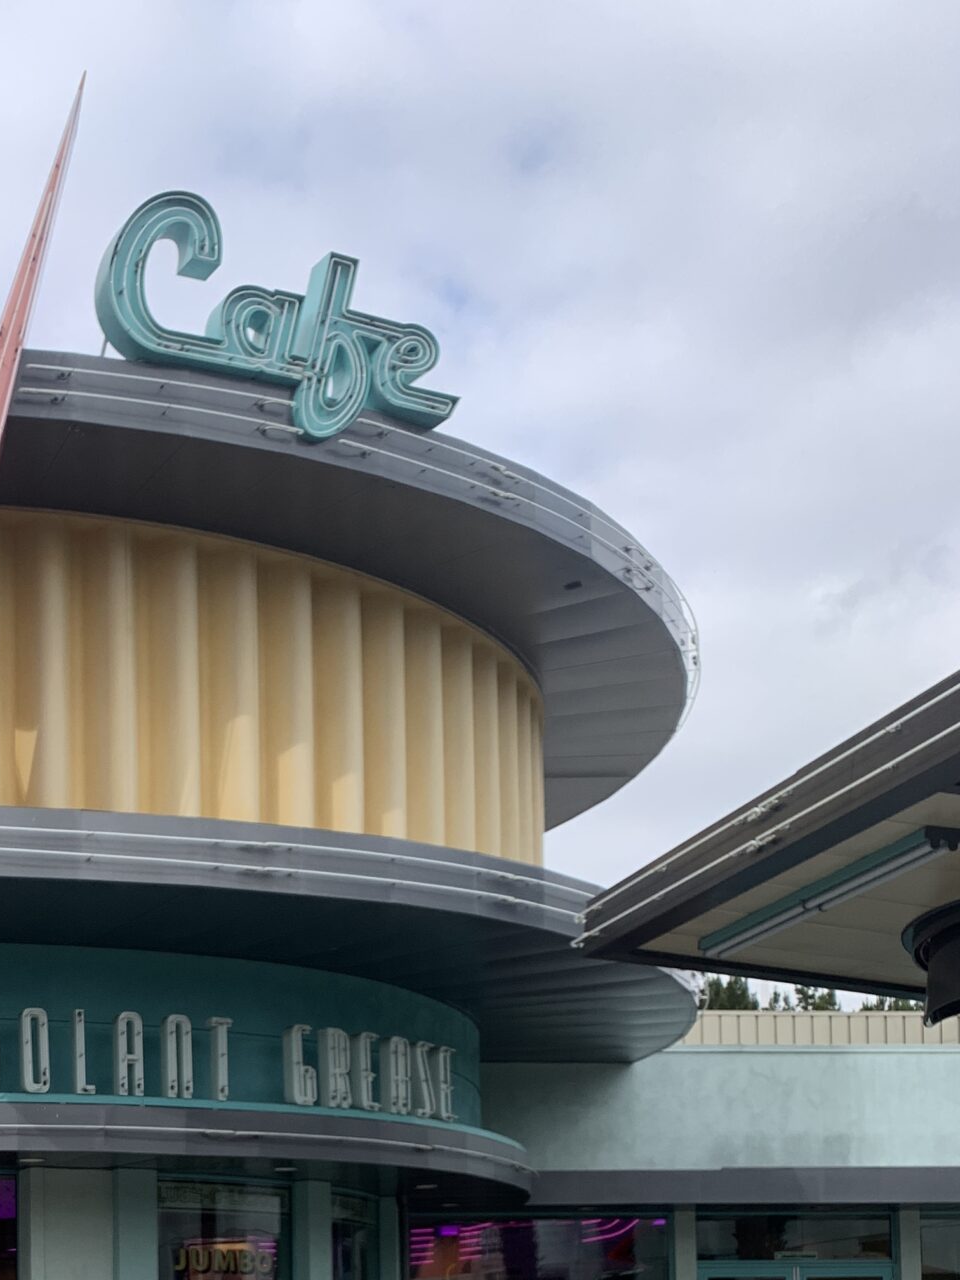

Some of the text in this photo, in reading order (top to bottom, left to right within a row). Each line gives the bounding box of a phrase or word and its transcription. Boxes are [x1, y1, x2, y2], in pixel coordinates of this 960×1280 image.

[94, 190, 461, 445] Cafe
[283, 1023, 458, 1122] GREASE
[174, 1247, 274, 1275] JUMBO
